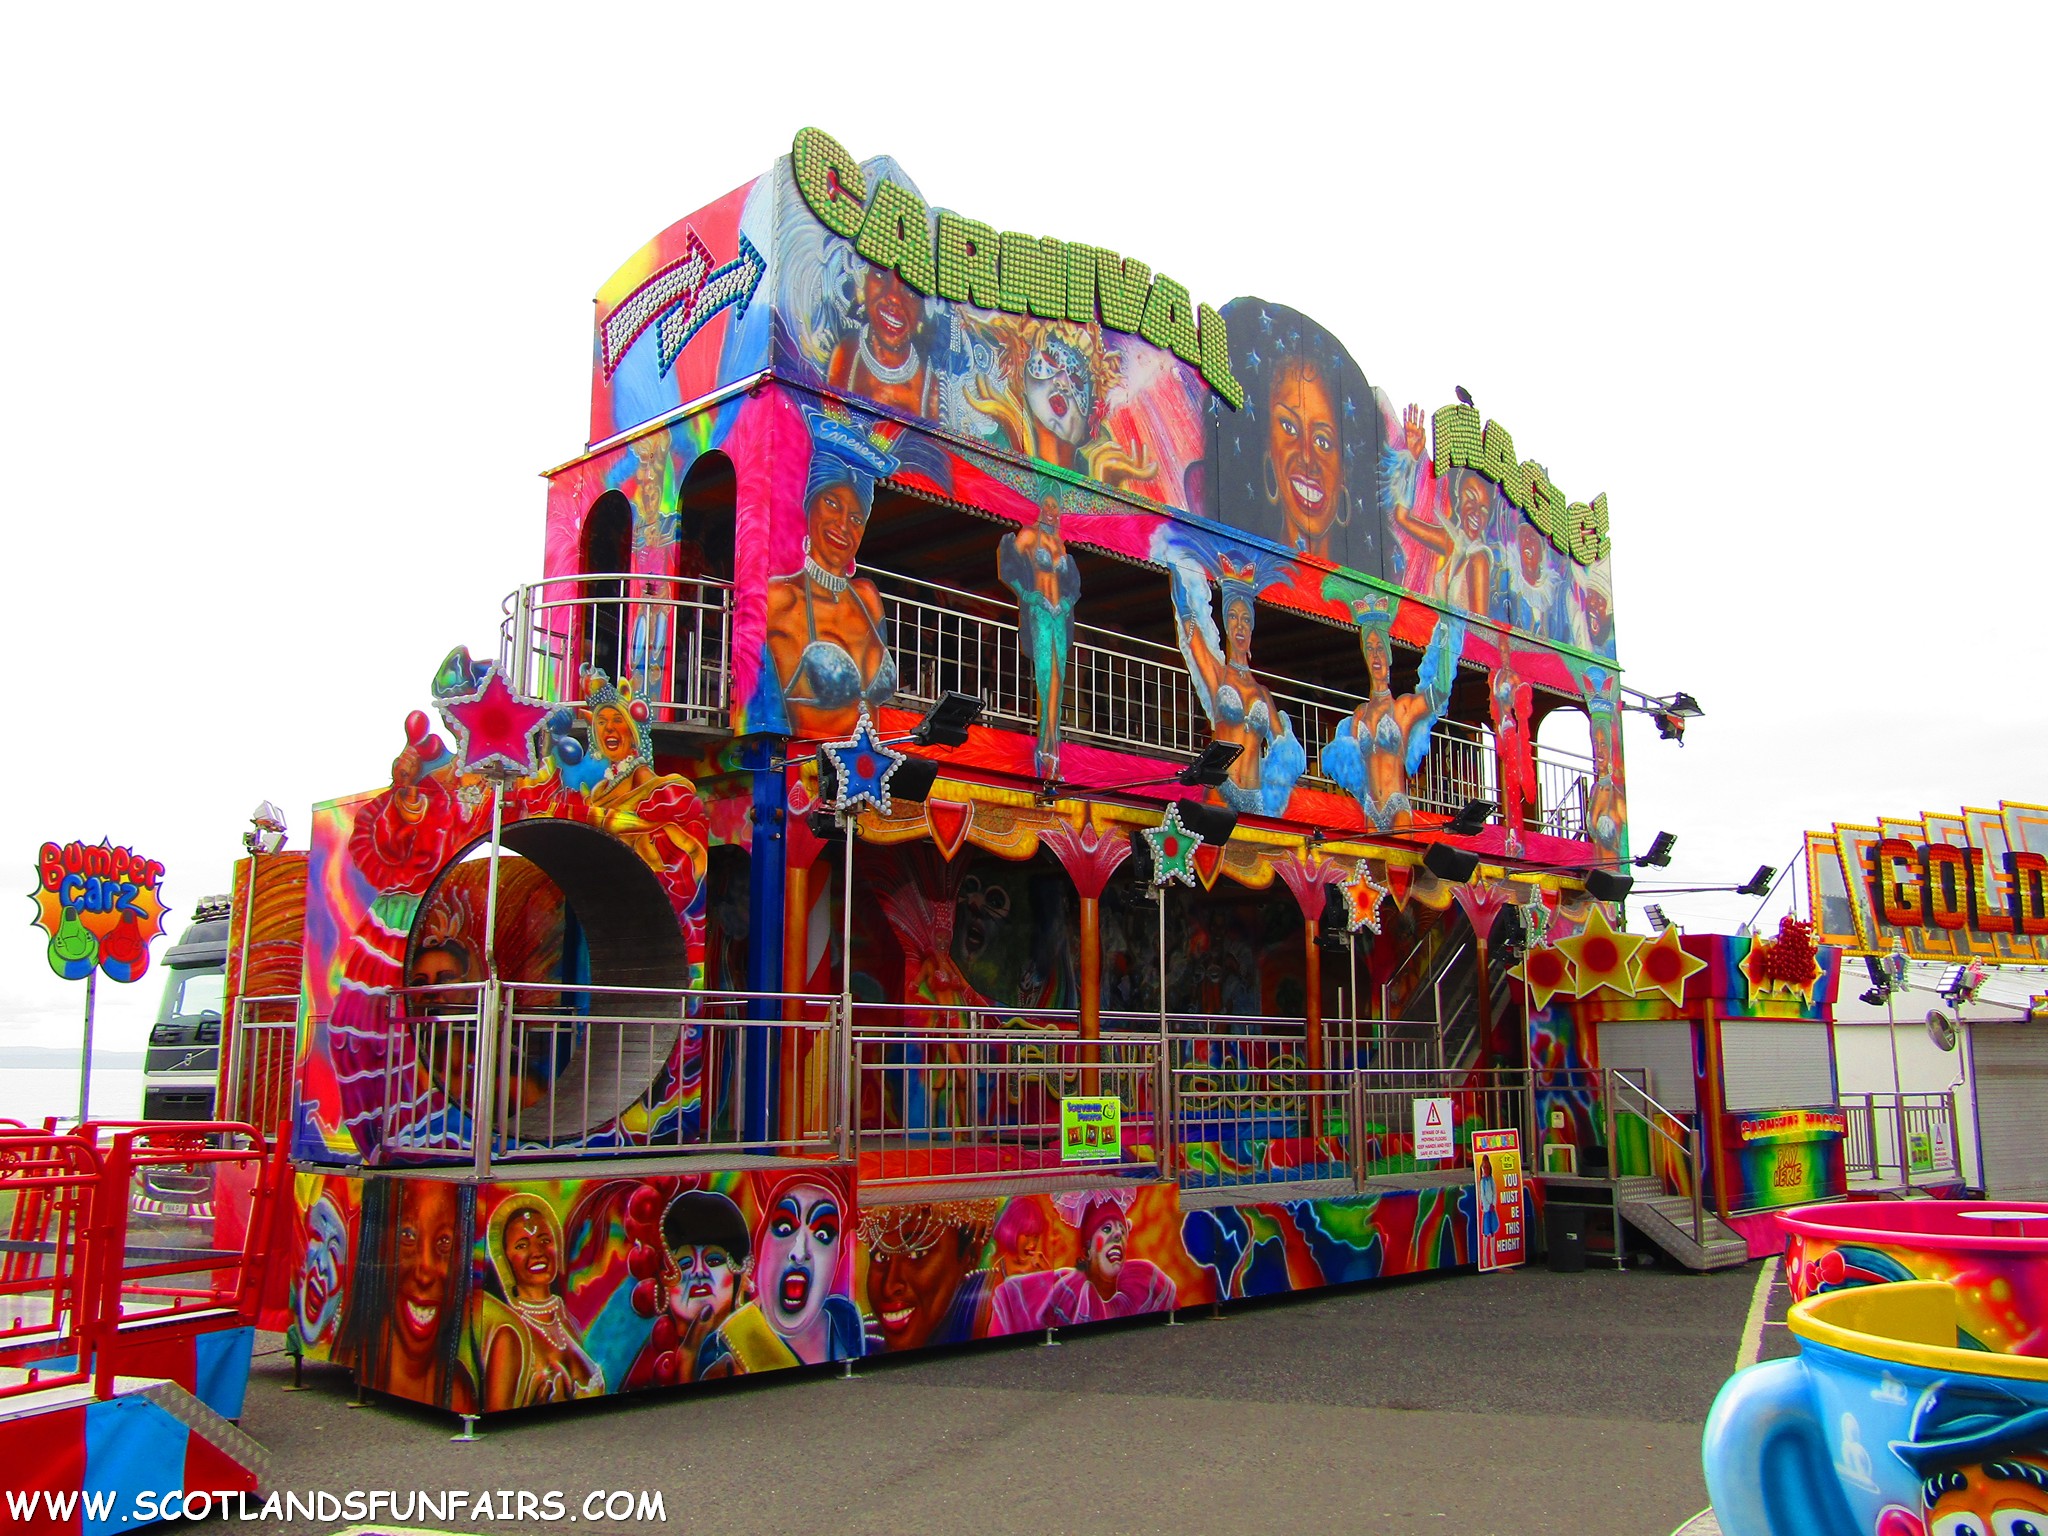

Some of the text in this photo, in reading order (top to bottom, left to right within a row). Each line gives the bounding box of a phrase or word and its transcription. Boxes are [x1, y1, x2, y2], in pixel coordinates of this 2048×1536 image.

[792, 127, 1244, 410] CARNIVAL
[39, 842, 165, 893] Bumper
[60, 874, 149, 919] Carz
[1868, 838, 2048, 936] GOLD
[1777, 1144, 1799, 1168] PAY
[1502, 1173, 1518, 1187] YOU
[1774, 1163, 1802, 1187] HERE
[1500, 1190, 1519, 1204] MUST
[1511, 1206, 1519, 1218] BE
[1505, 1222, 1520, 1235] THIS
[1496, 1237, 1520, 1252] HEIGHT
